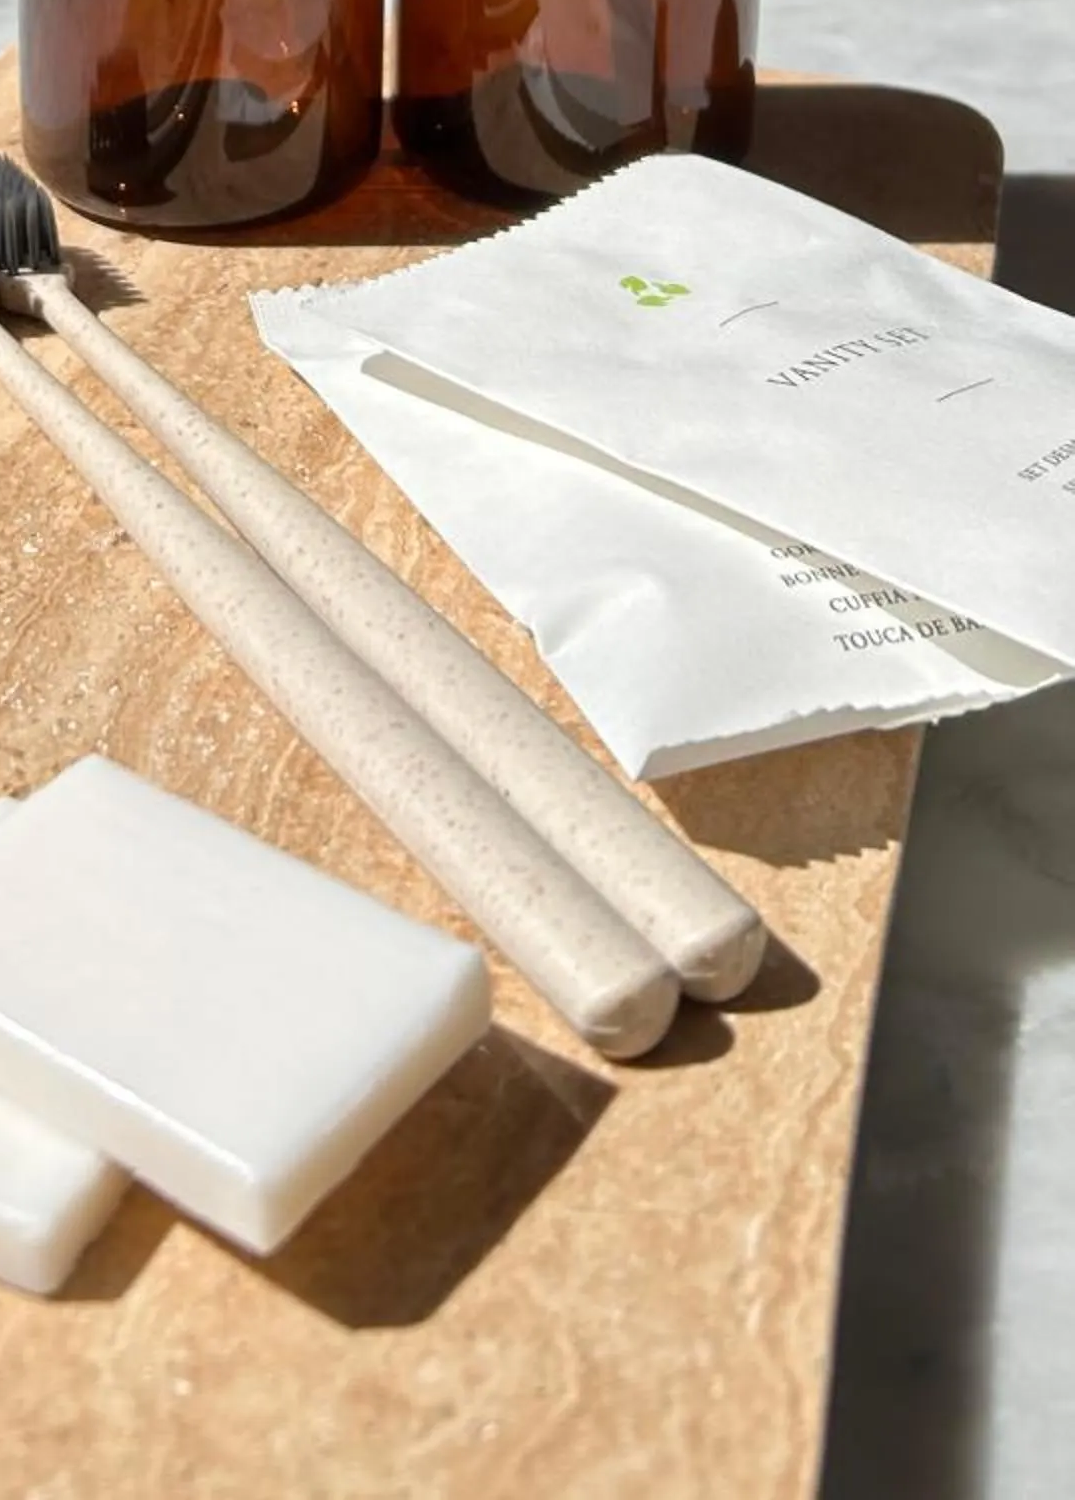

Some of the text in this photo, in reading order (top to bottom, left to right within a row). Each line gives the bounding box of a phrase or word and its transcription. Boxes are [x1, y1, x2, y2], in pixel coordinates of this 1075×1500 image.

[766, 327, 930, 388] VANITY SET
[829, 589, 909, 613] CUFFIA
[834, 626, 914, 651] TOUCA
[915, 619, 949, 639] DE
